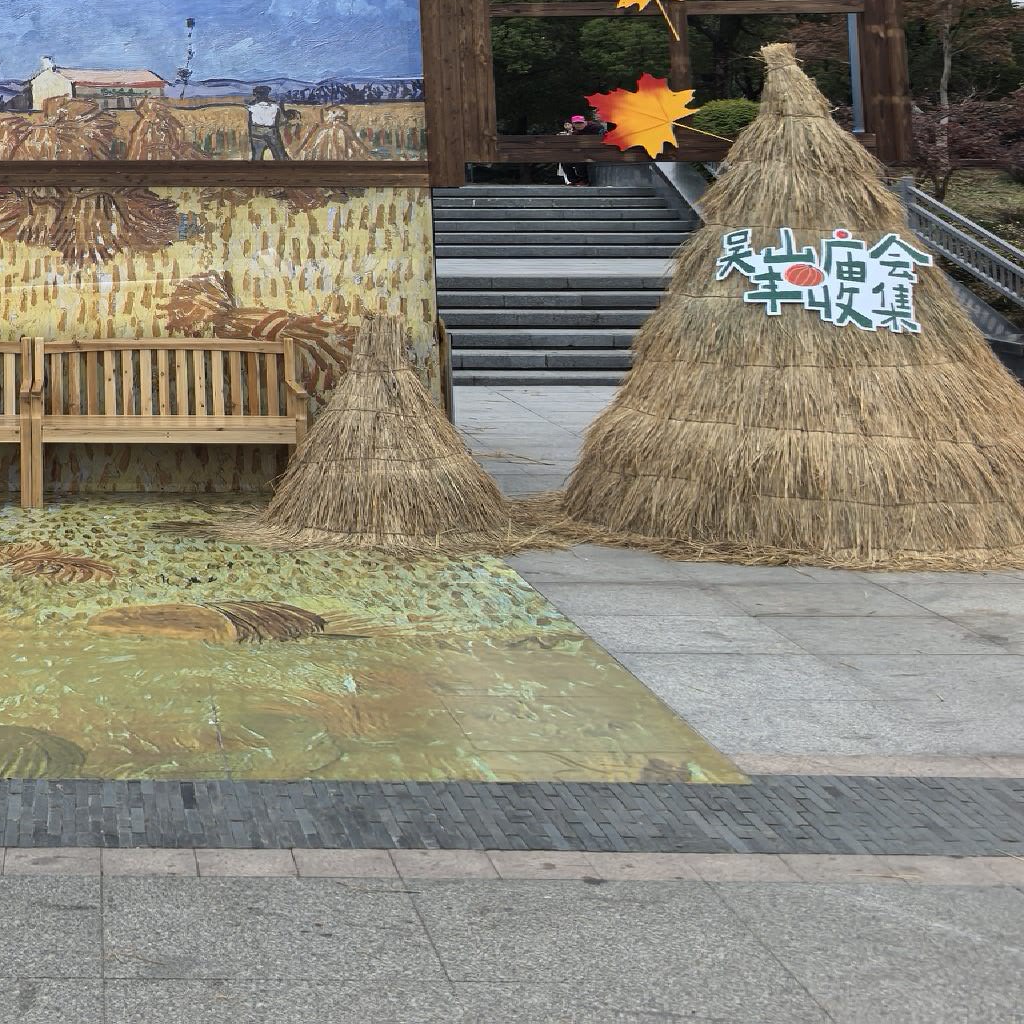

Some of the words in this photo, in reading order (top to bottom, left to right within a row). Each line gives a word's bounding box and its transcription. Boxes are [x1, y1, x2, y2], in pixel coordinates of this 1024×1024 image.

[717, 228, 930, 282] 吴山庙会
[746, 265, 919, 331] 丰收集
